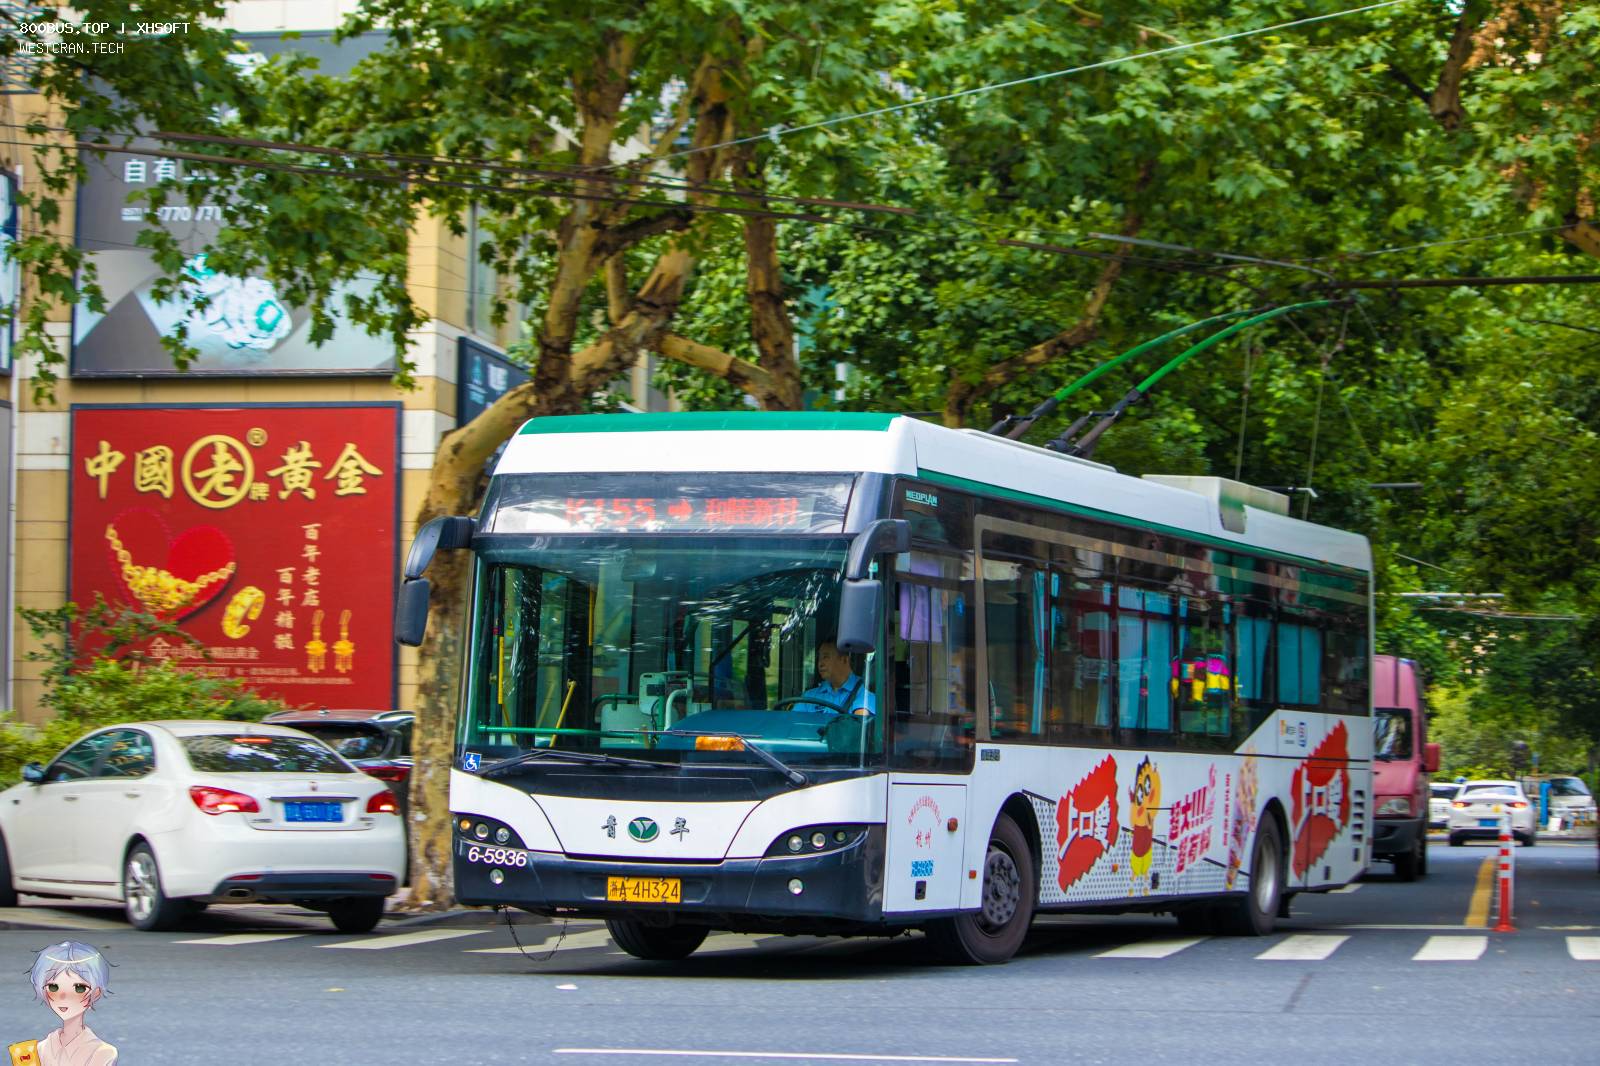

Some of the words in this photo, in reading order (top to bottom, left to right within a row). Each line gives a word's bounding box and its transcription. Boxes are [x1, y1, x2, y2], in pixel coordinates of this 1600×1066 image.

[905, 489, 938, 507] NEOPLAN
[301, 523, 323, 606] 百年老店
[468, 846, 528, 867] 6-5936
